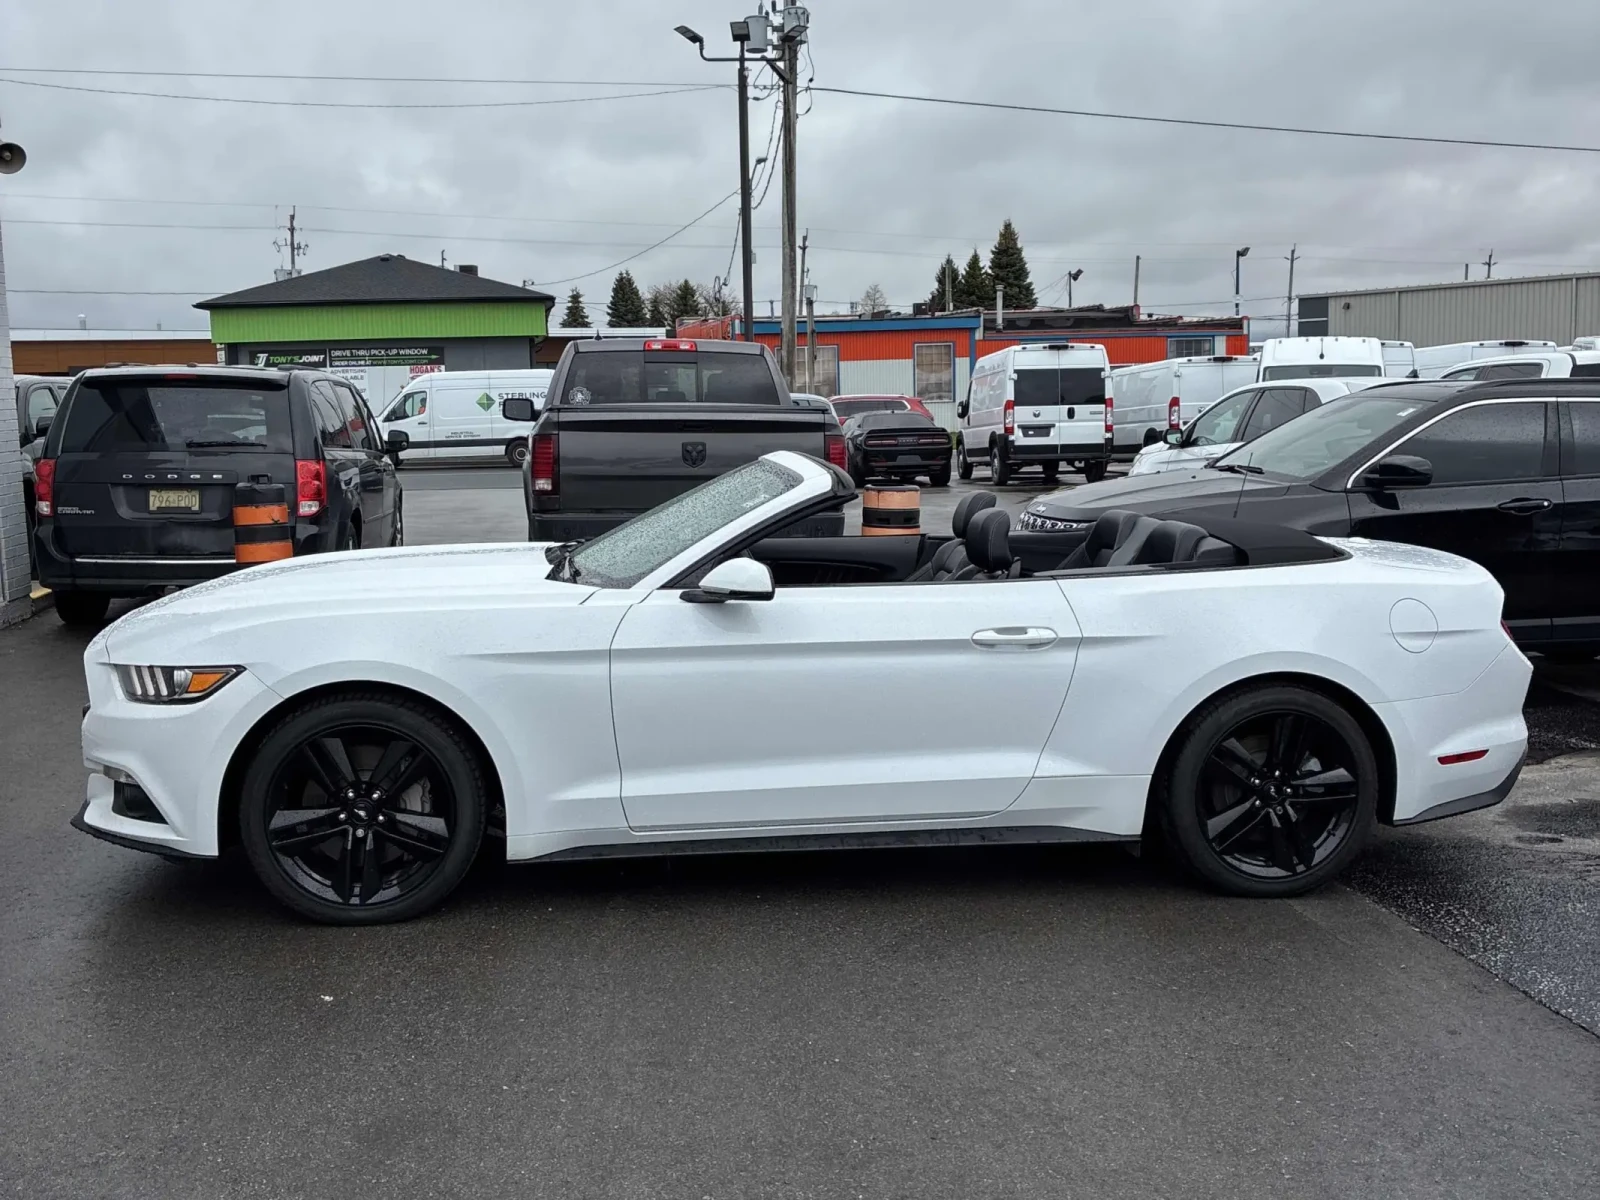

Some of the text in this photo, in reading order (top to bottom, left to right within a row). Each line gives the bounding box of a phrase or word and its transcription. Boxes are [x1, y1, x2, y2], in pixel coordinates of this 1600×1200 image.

[410, 365, 442, 374] HOGAN'S
[498, 392, 547, 400] STERLING
[151, 494, 171, 507] 796
